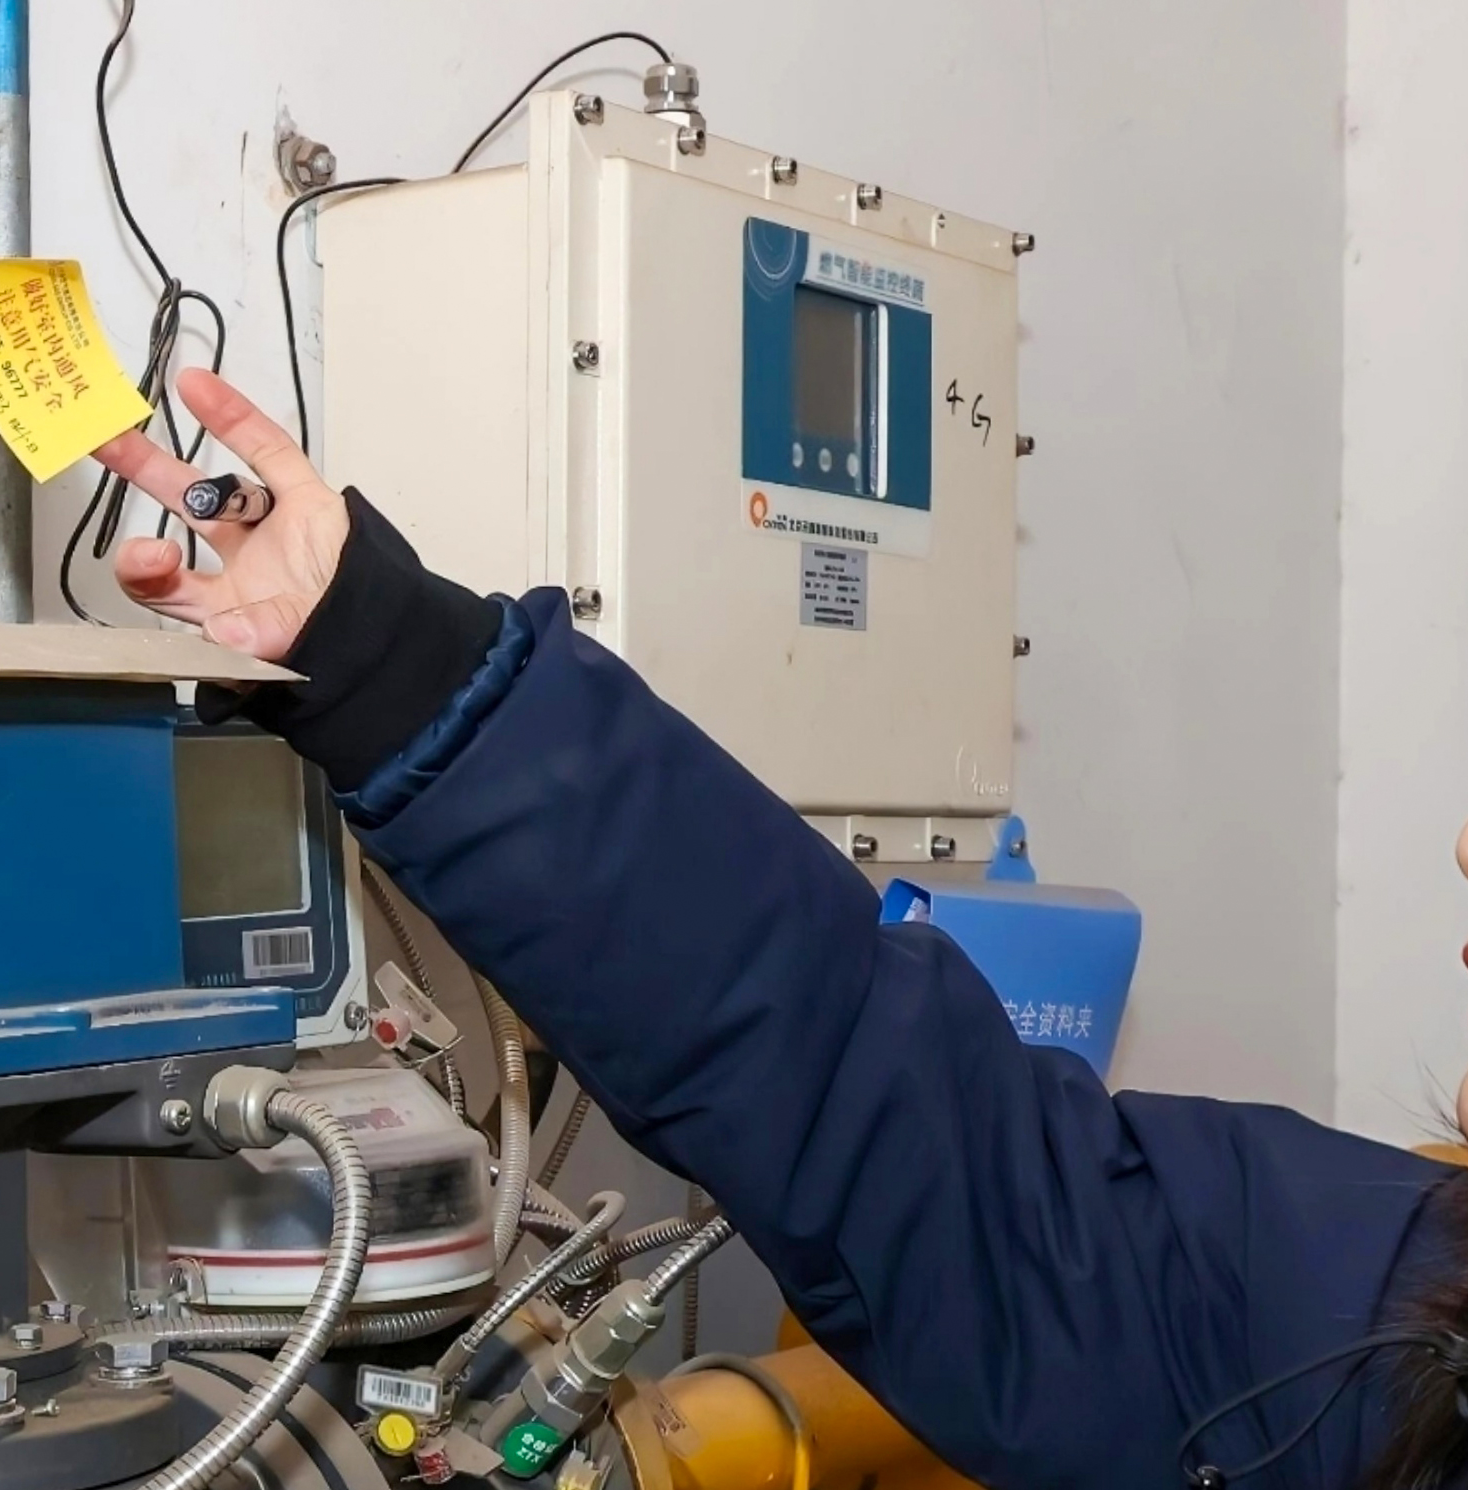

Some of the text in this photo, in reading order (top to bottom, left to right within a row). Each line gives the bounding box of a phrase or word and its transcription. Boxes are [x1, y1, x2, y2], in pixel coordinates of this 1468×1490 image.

[21, 277, 90, 400] 做好室内通风
